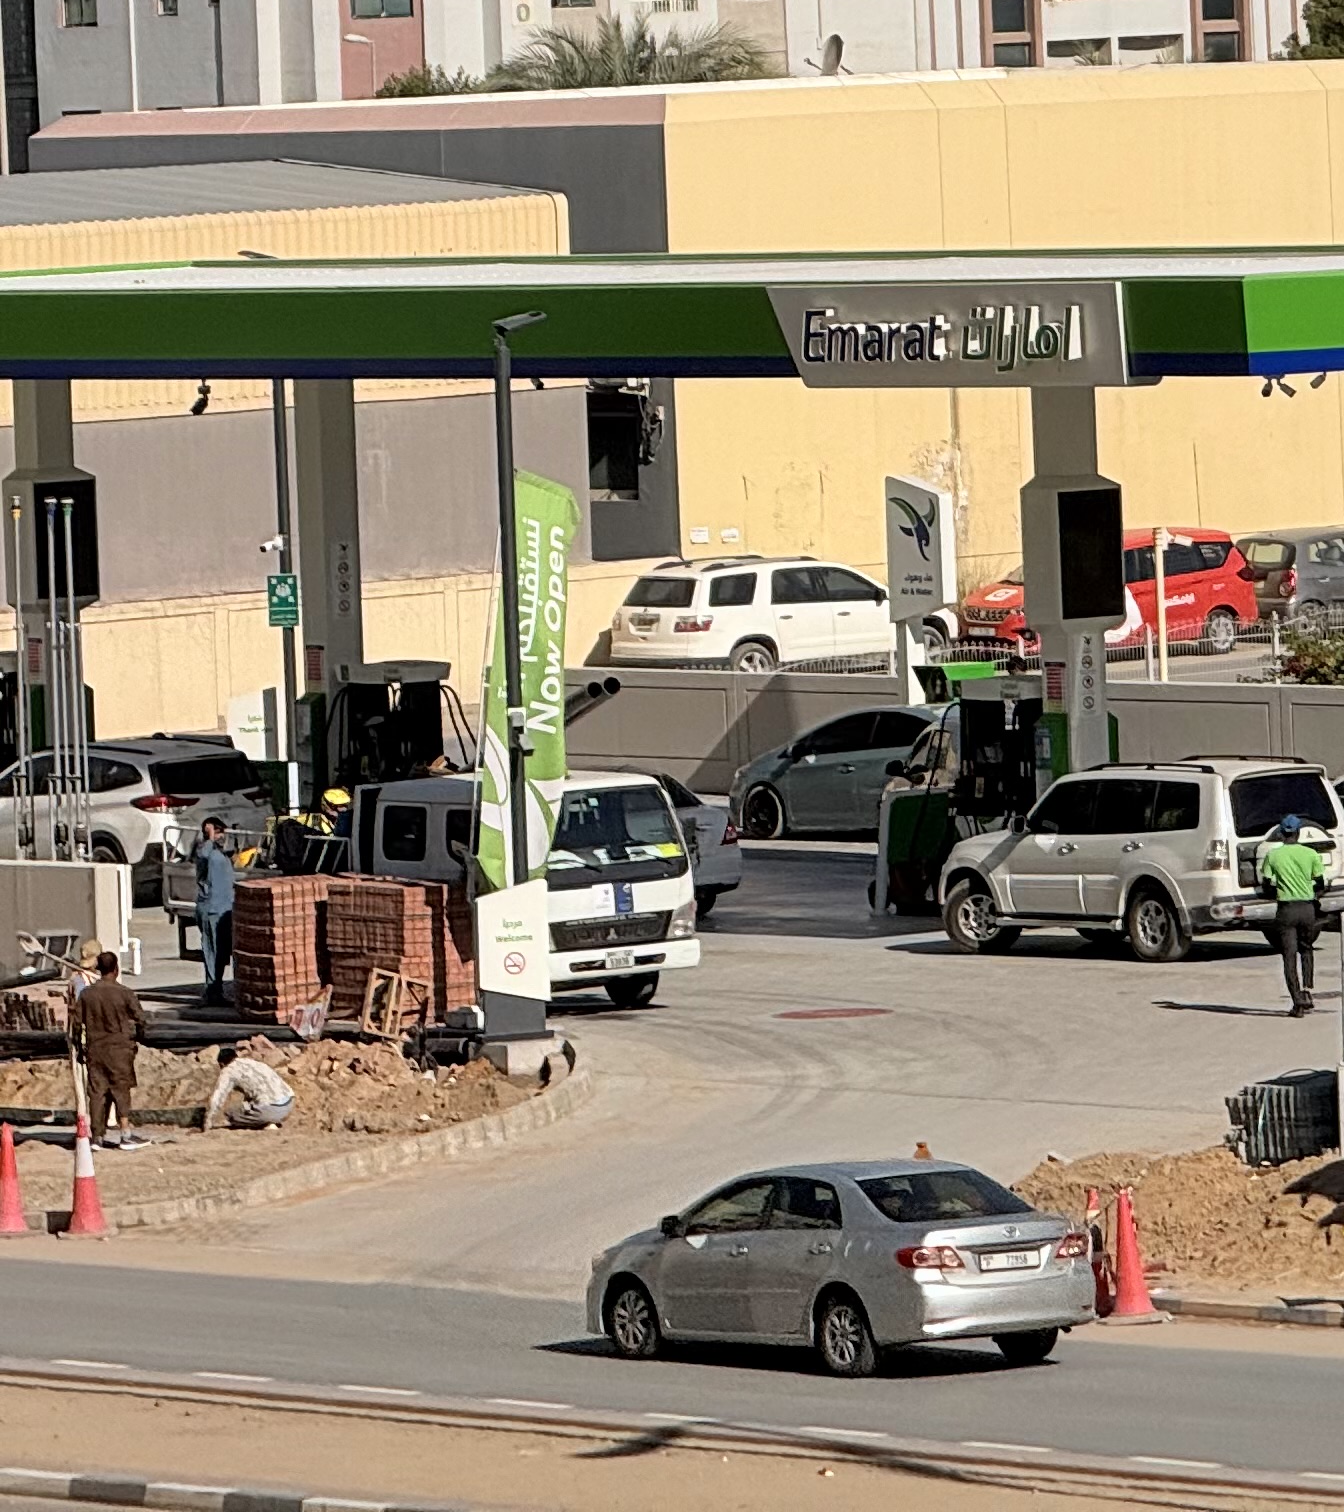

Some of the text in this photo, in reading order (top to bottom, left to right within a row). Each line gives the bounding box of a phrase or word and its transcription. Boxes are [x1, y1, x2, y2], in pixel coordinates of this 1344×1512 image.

[802, 308, 947, 364] Emarat
[961, 304, 1083, 373] امارات
[525, 524, 567, 735] Now Open
